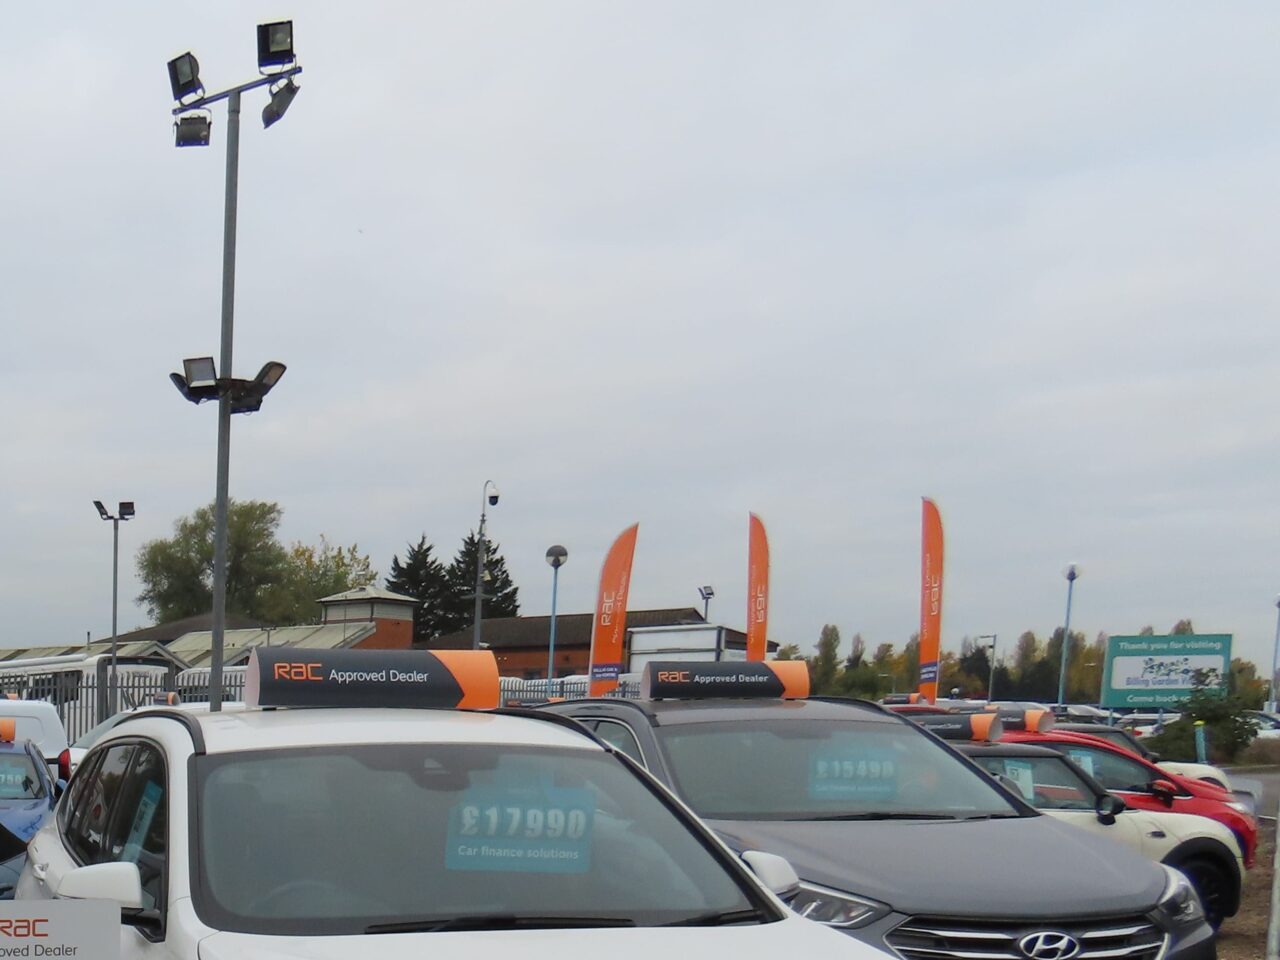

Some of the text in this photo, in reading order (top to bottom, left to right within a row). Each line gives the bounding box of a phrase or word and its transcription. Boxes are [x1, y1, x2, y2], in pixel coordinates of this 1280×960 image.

[329, 669, 386, 684] Approved
[390, 670, 429, 682] Dealer
[693, 675, 736, 684] Approved
[738, 674, 769, 682] Dealer
[460, 806, 587, 839] £17990
[458, 845, 579, 859] Car finance solutions
[34, 944, 78, 957] Dealer
